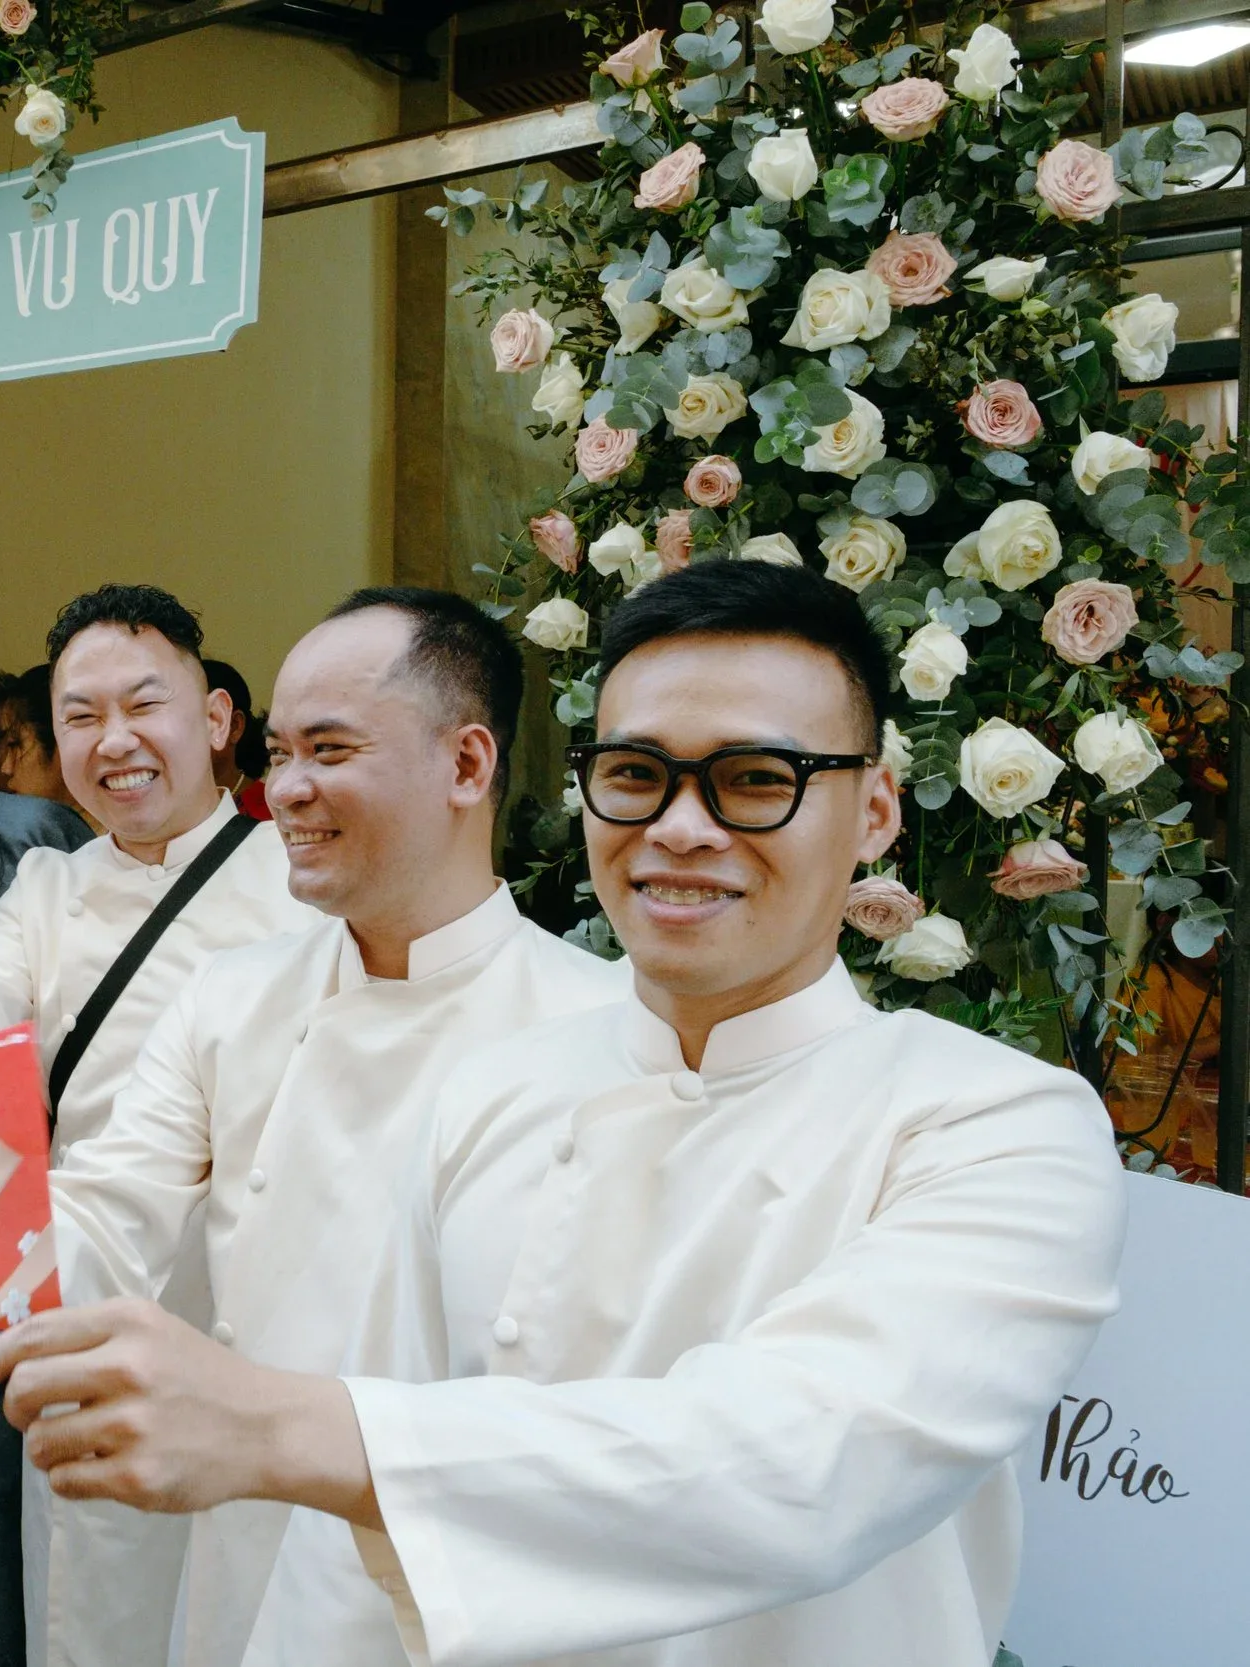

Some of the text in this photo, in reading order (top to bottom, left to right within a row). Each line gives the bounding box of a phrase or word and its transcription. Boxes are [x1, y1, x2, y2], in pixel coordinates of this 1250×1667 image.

[8, 218, 81, 318] VU
[102, 187, 220, 305] QUY
[1040, 1394, 1190, 1504] Thảo
